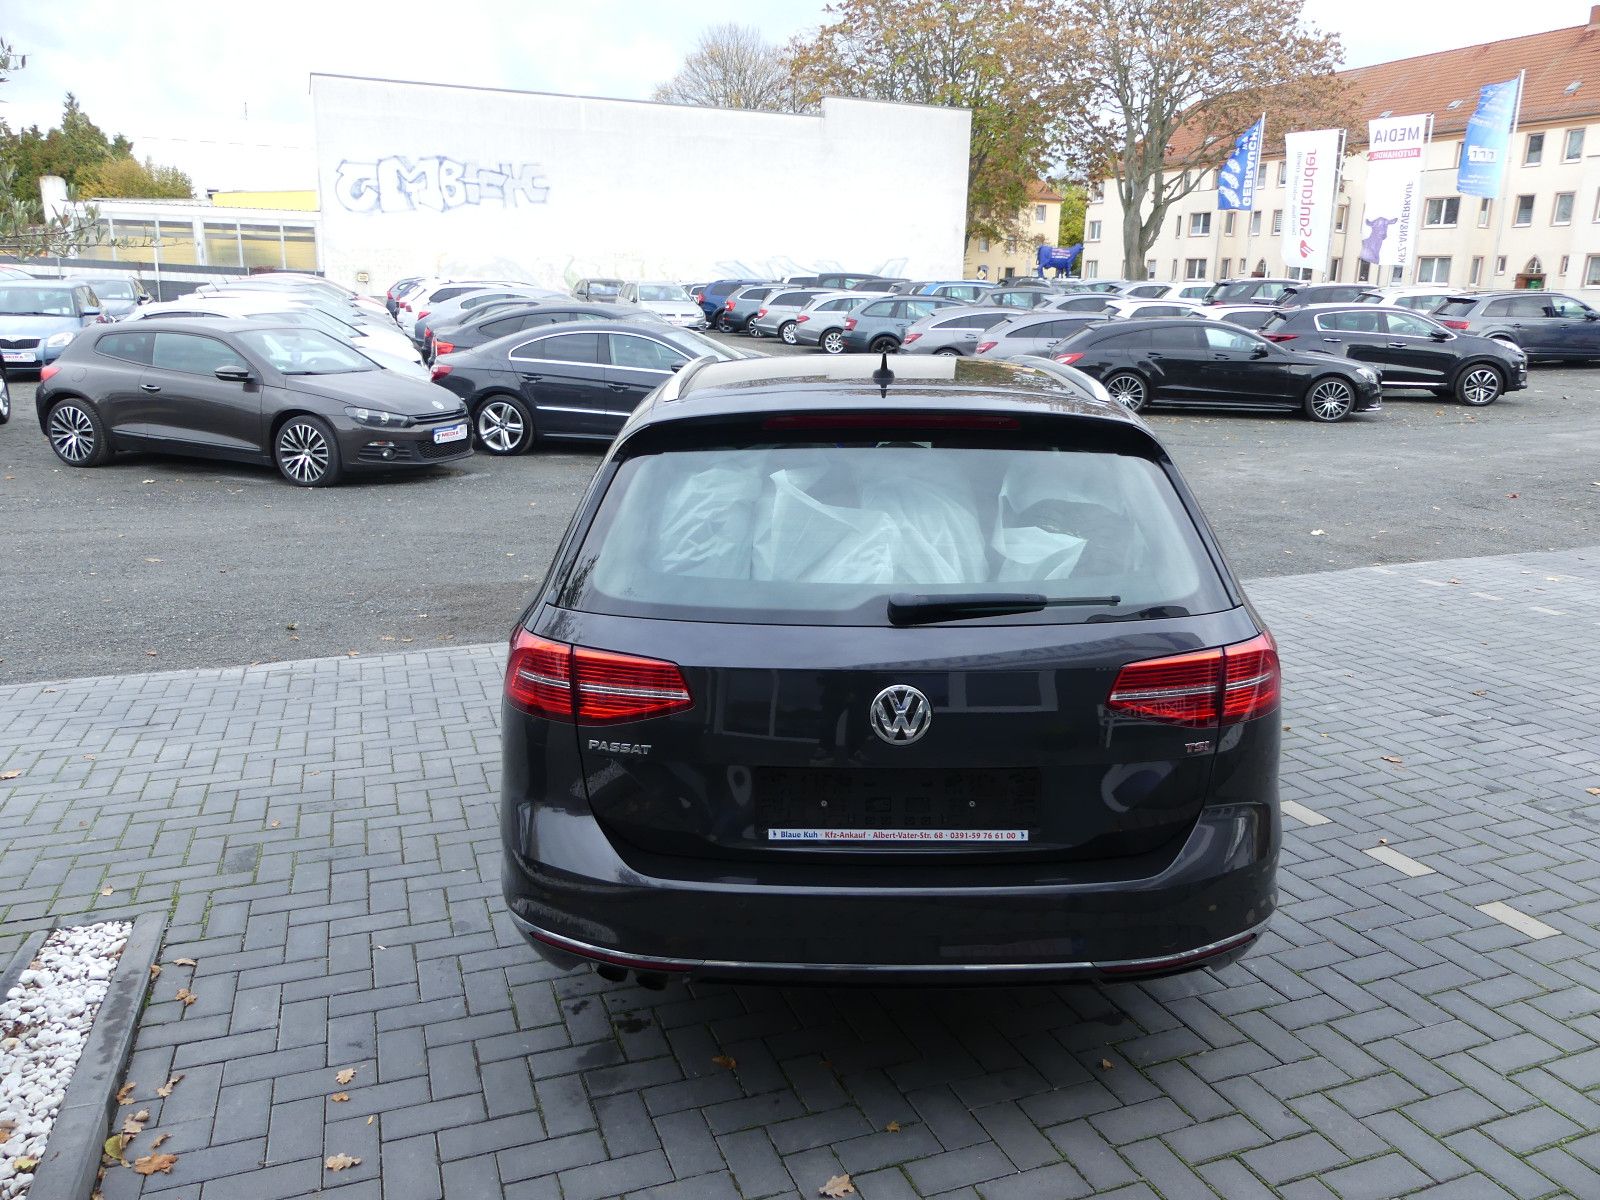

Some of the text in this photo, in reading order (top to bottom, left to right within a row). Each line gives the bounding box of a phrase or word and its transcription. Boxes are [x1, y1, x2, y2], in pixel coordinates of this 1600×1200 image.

[588, 739, 652, 755] PASSAT
[1185, 740, 1210, 753] TSI
[780, 831, 1016, 839] Blaue Kuh Kfz-Ankauf Albert-Vater-Str. 68 0391-59 76 61 00
